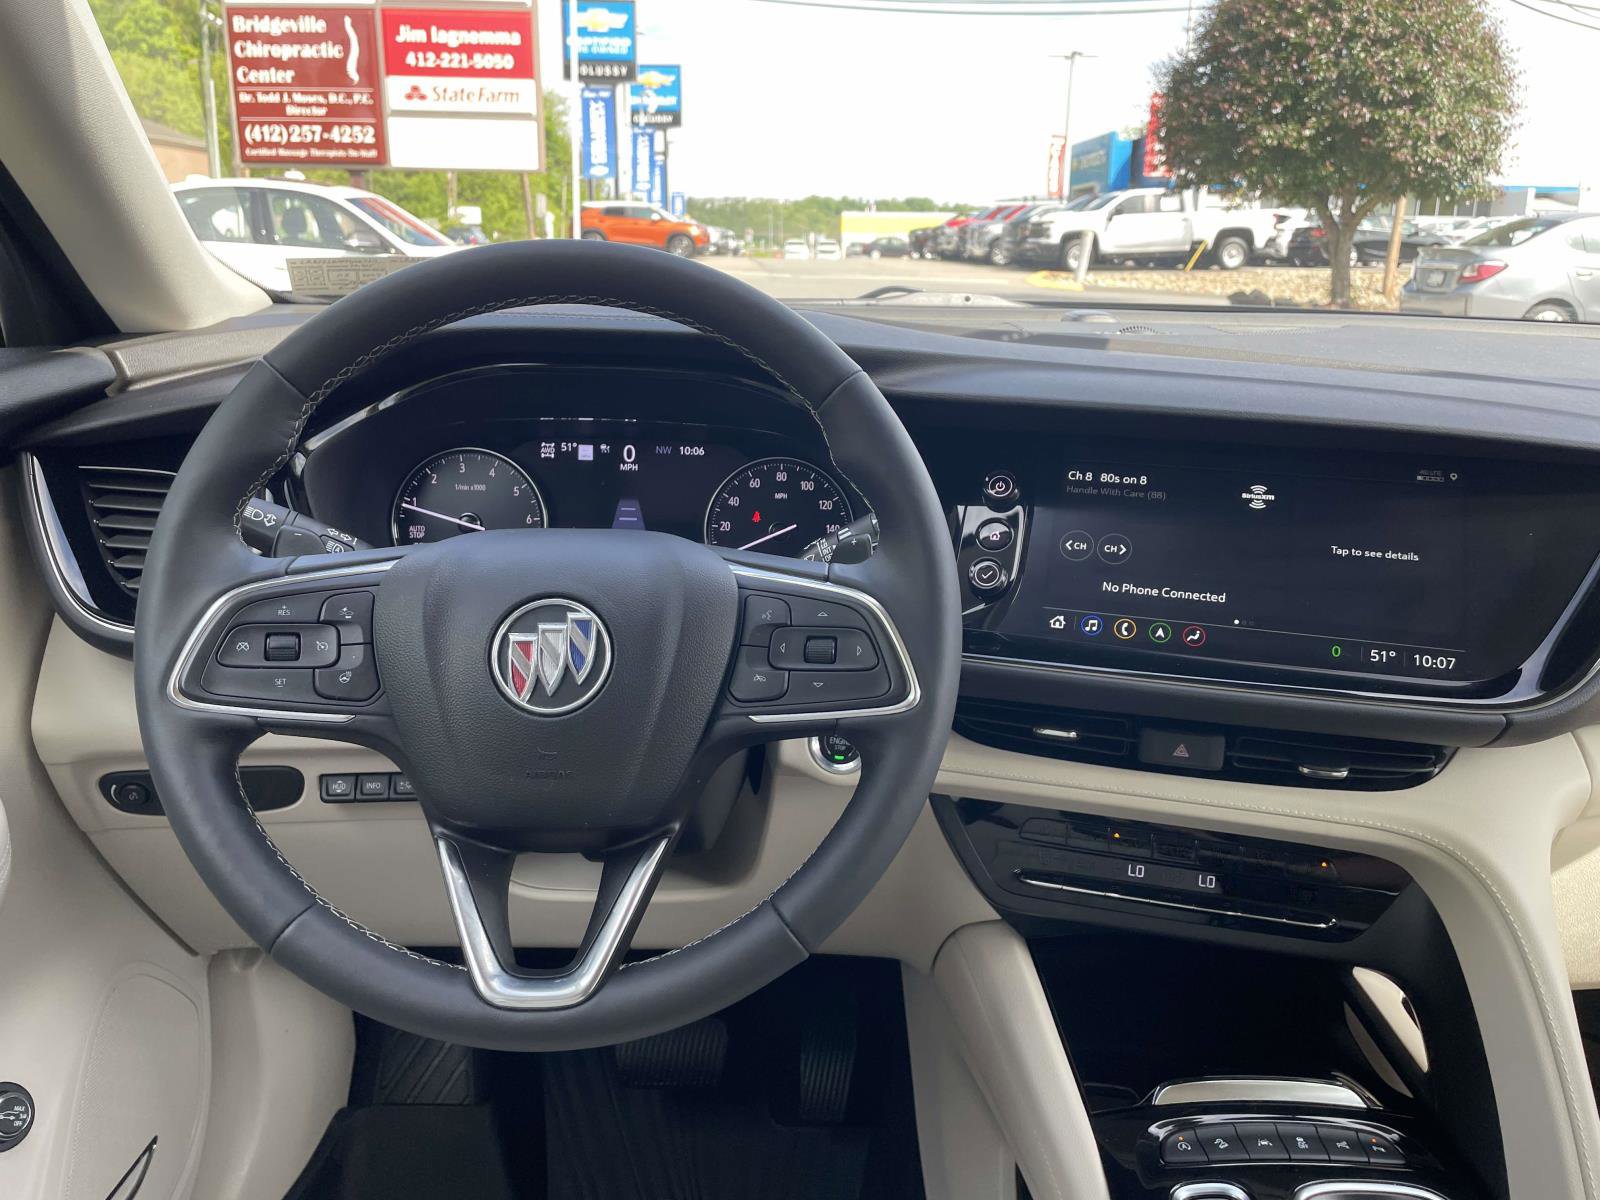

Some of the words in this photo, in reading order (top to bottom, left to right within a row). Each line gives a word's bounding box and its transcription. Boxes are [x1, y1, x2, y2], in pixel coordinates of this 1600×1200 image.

[232, 15, 327, 36] Bridgeville
[395, 24, 427, 43] Jim
[431, 25, 521, 47] Iagnemma
[234, 40, 344, 60] Chiropractic
[405, 51, 514, 69] 412-221-5050
[236, 65, 295, 83] Center
[623, 444, 636, 463] 0
[655, 446, 672, 455] NW
[679, 446, 705, 456] 10:06
[459, 463, 466, 473] 3
[620, 463, 638, 471] MPH
[489, 468, 495, 478] 4
[776, 472, 787, 482] 80
[1068, 470, 1083, 481] Ch
[1085, 472, 1093, 481] 8
[1100, 473, 1120, 483] 80s
[1123, 476, 1137, 484] on
[1139, 475, 1148, 485] 8
[431, 474, 438, 484] 2
[749, 478, 761, 488] 60
[513, 486, 520, 496] 5
[800, 480, 815, 491] 100
[774, 492, 788, 500] MPH
[1066, 485, 1098, 495] Handle
[1100, 487, 1121, 497] With
[1123, 489, 1145, 498] Care
[412, 497, 417, 507] 1
[728, 496, 739, 507] 40
[819, 500, 833, 510] 120
[526, 514, 532, 524] 6
[720, 521, 731, 532] 20
[1073, 542, 1087, 550] CH
[1104, 544, 1118, 553] CH
[1331, 545, 1349, 557] Tap
[1351, 548, 1362, 556] to
[1364, 550, 1382, 558] see
[1384, 550, 1419, 561] details
[1102, 581, 1119, 593] No
[1121, 583, 1159, 596] Phone
[1161, 587, 1226, 603] Connected
[1413, 654, 1456, 670] 10:07
[1127, 863, 1145, 878] LO
[1198, 874, 1216, 888] LO
